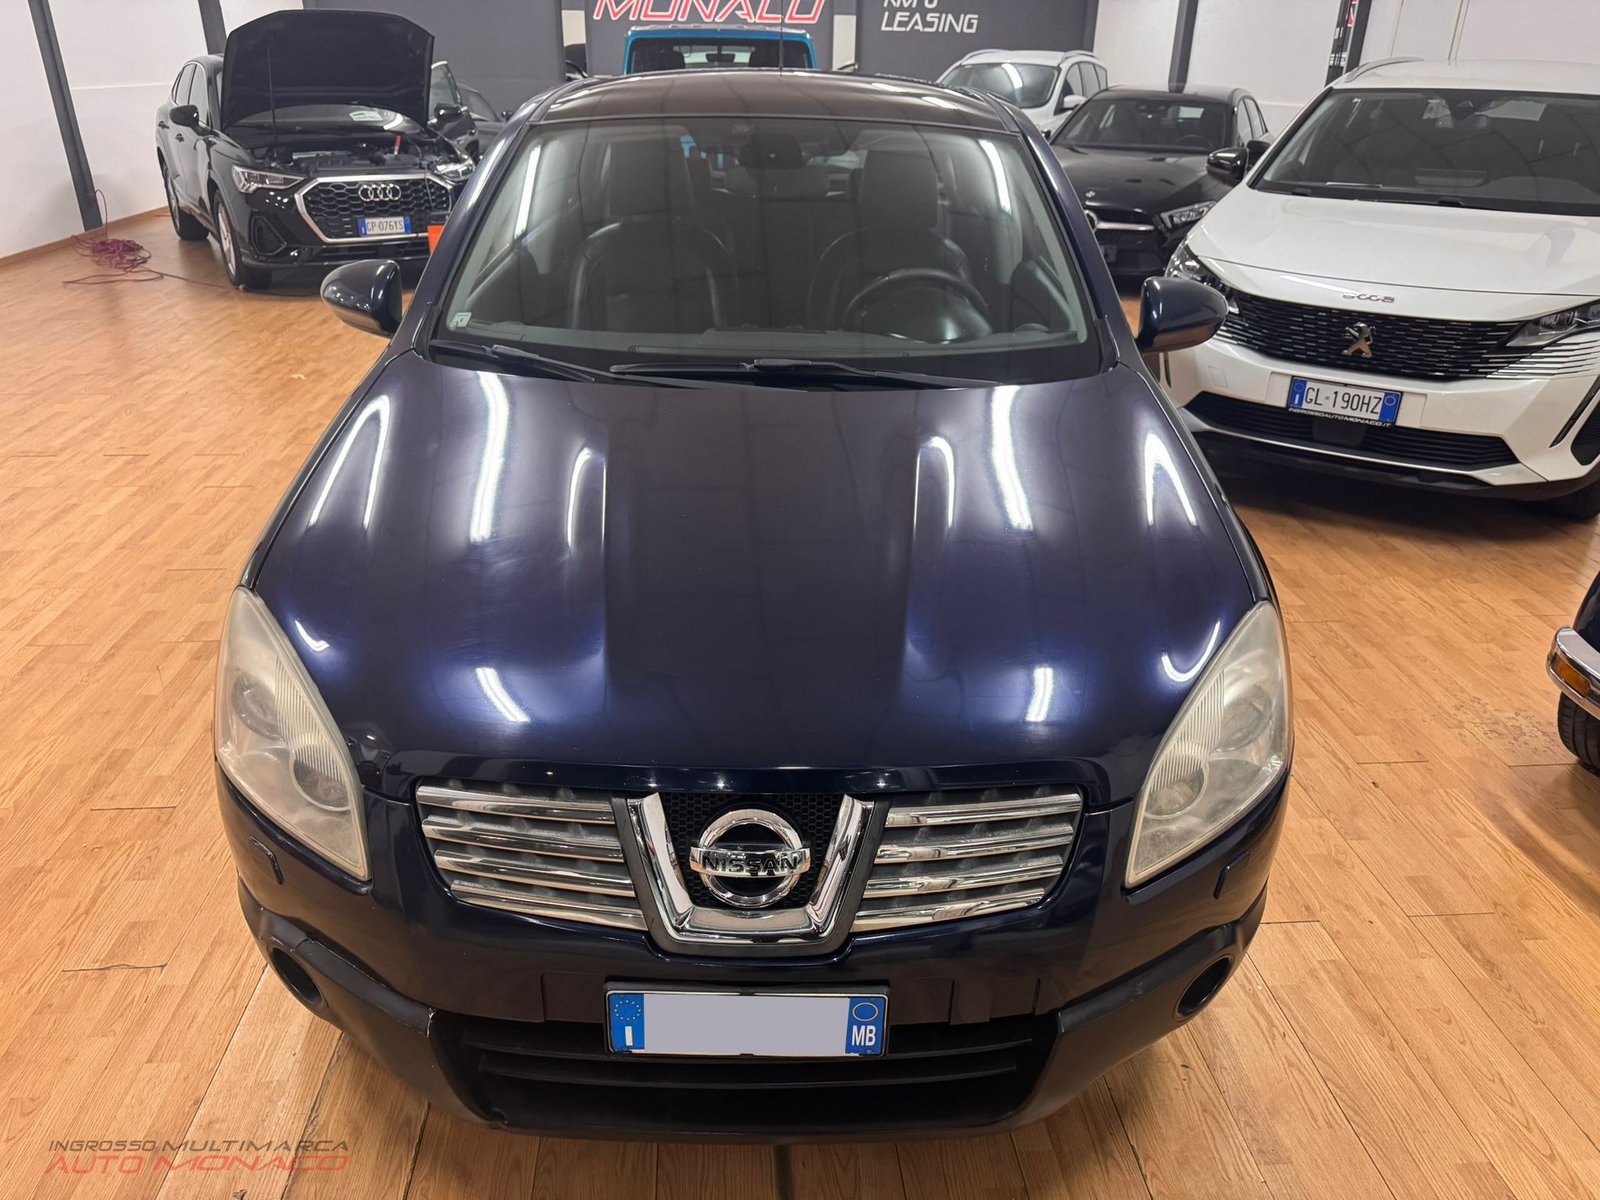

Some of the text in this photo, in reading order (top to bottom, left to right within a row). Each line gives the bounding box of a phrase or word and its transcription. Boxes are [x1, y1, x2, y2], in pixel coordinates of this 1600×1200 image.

[881, 11, 979, 33] LEASING
[702, 856, 799, 873] NISSAN
[851, 1025, 876, 1046] MB
